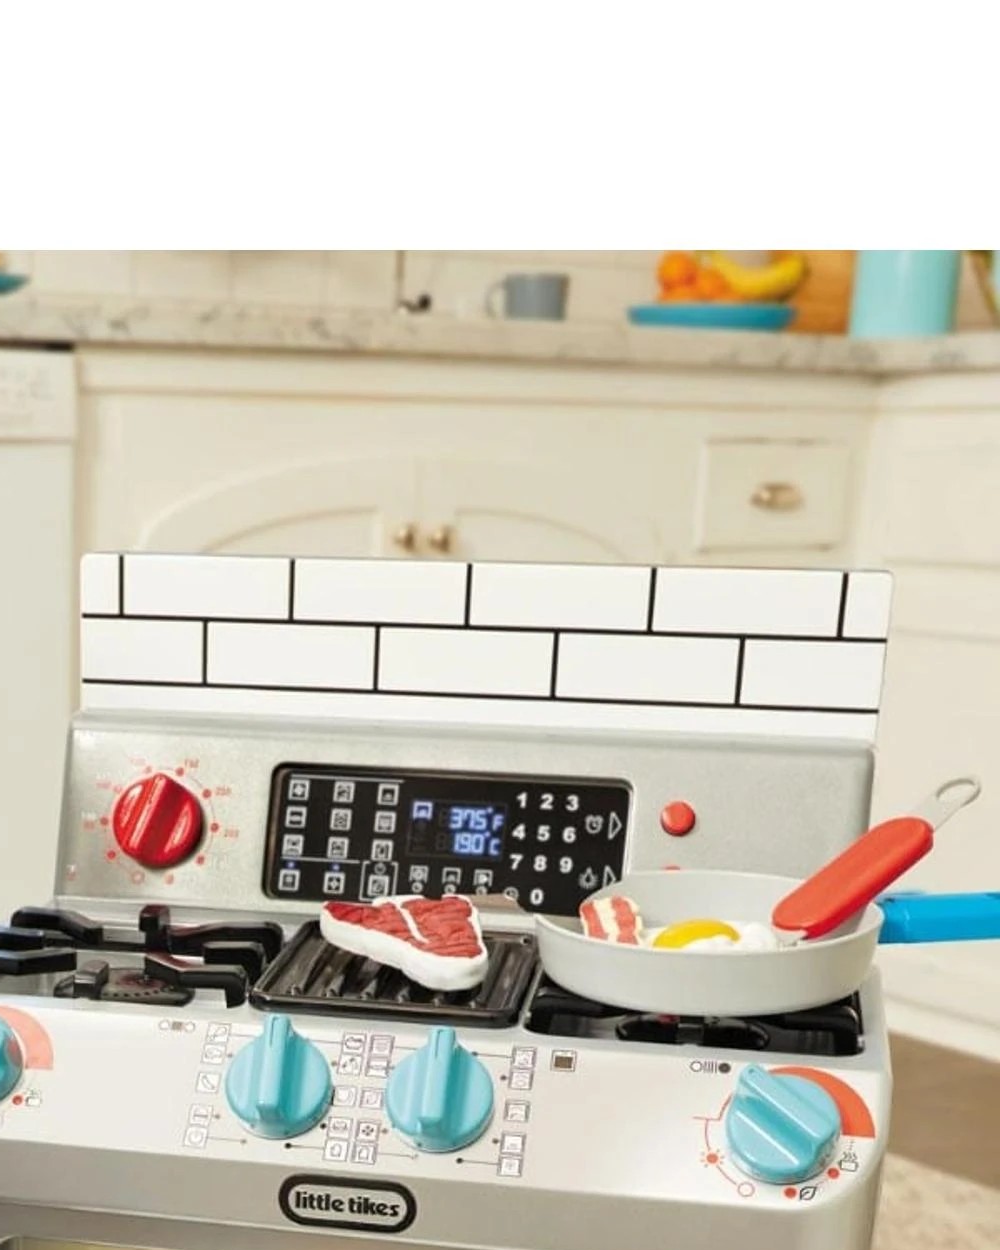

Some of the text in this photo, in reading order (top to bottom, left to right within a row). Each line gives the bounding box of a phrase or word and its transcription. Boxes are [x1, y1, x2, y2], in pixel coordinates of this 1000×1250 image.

[516, 791, 579, 812] 1 2 3
[512, 823, 576, 843] 4 5 6
[510, 853, 573, 873] 7 8 9
[530, 888, 544, 905] 0
[295, 1191, 400, 1217] little tikes
